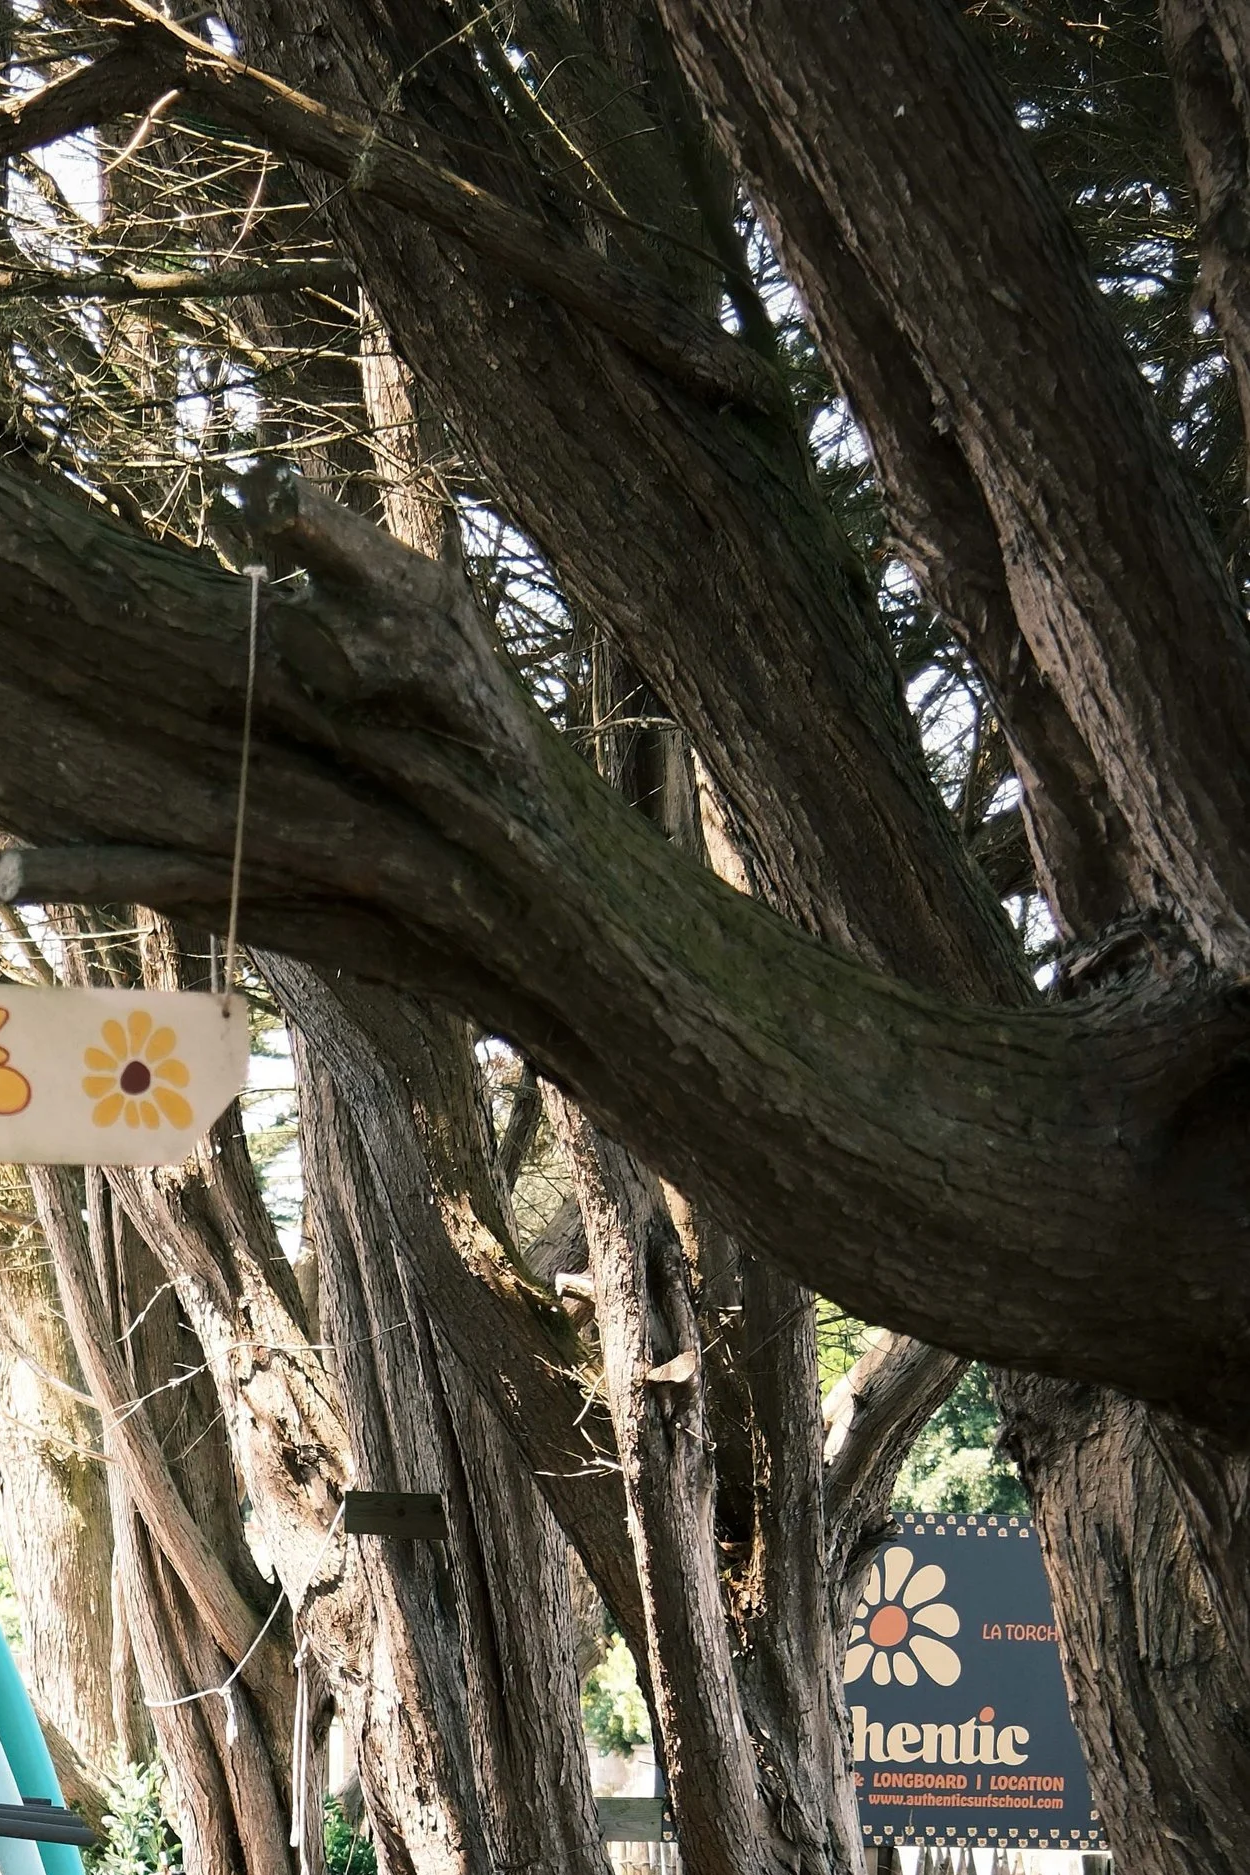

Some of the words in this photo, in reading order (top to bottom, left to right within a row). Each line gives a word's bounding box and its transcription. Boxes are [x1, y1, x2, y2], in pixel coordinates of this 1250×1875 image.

[982, 1624, 1002, 1640] LA
[1005, 1623, 1059, 1642] TORCH
[872, 1771, 968, 1790] LONGBOARD
[989, 1775, 1064, 1792] LOCATION
[868, 1793, 1064, 1809] www.authenticsurfschool.com
